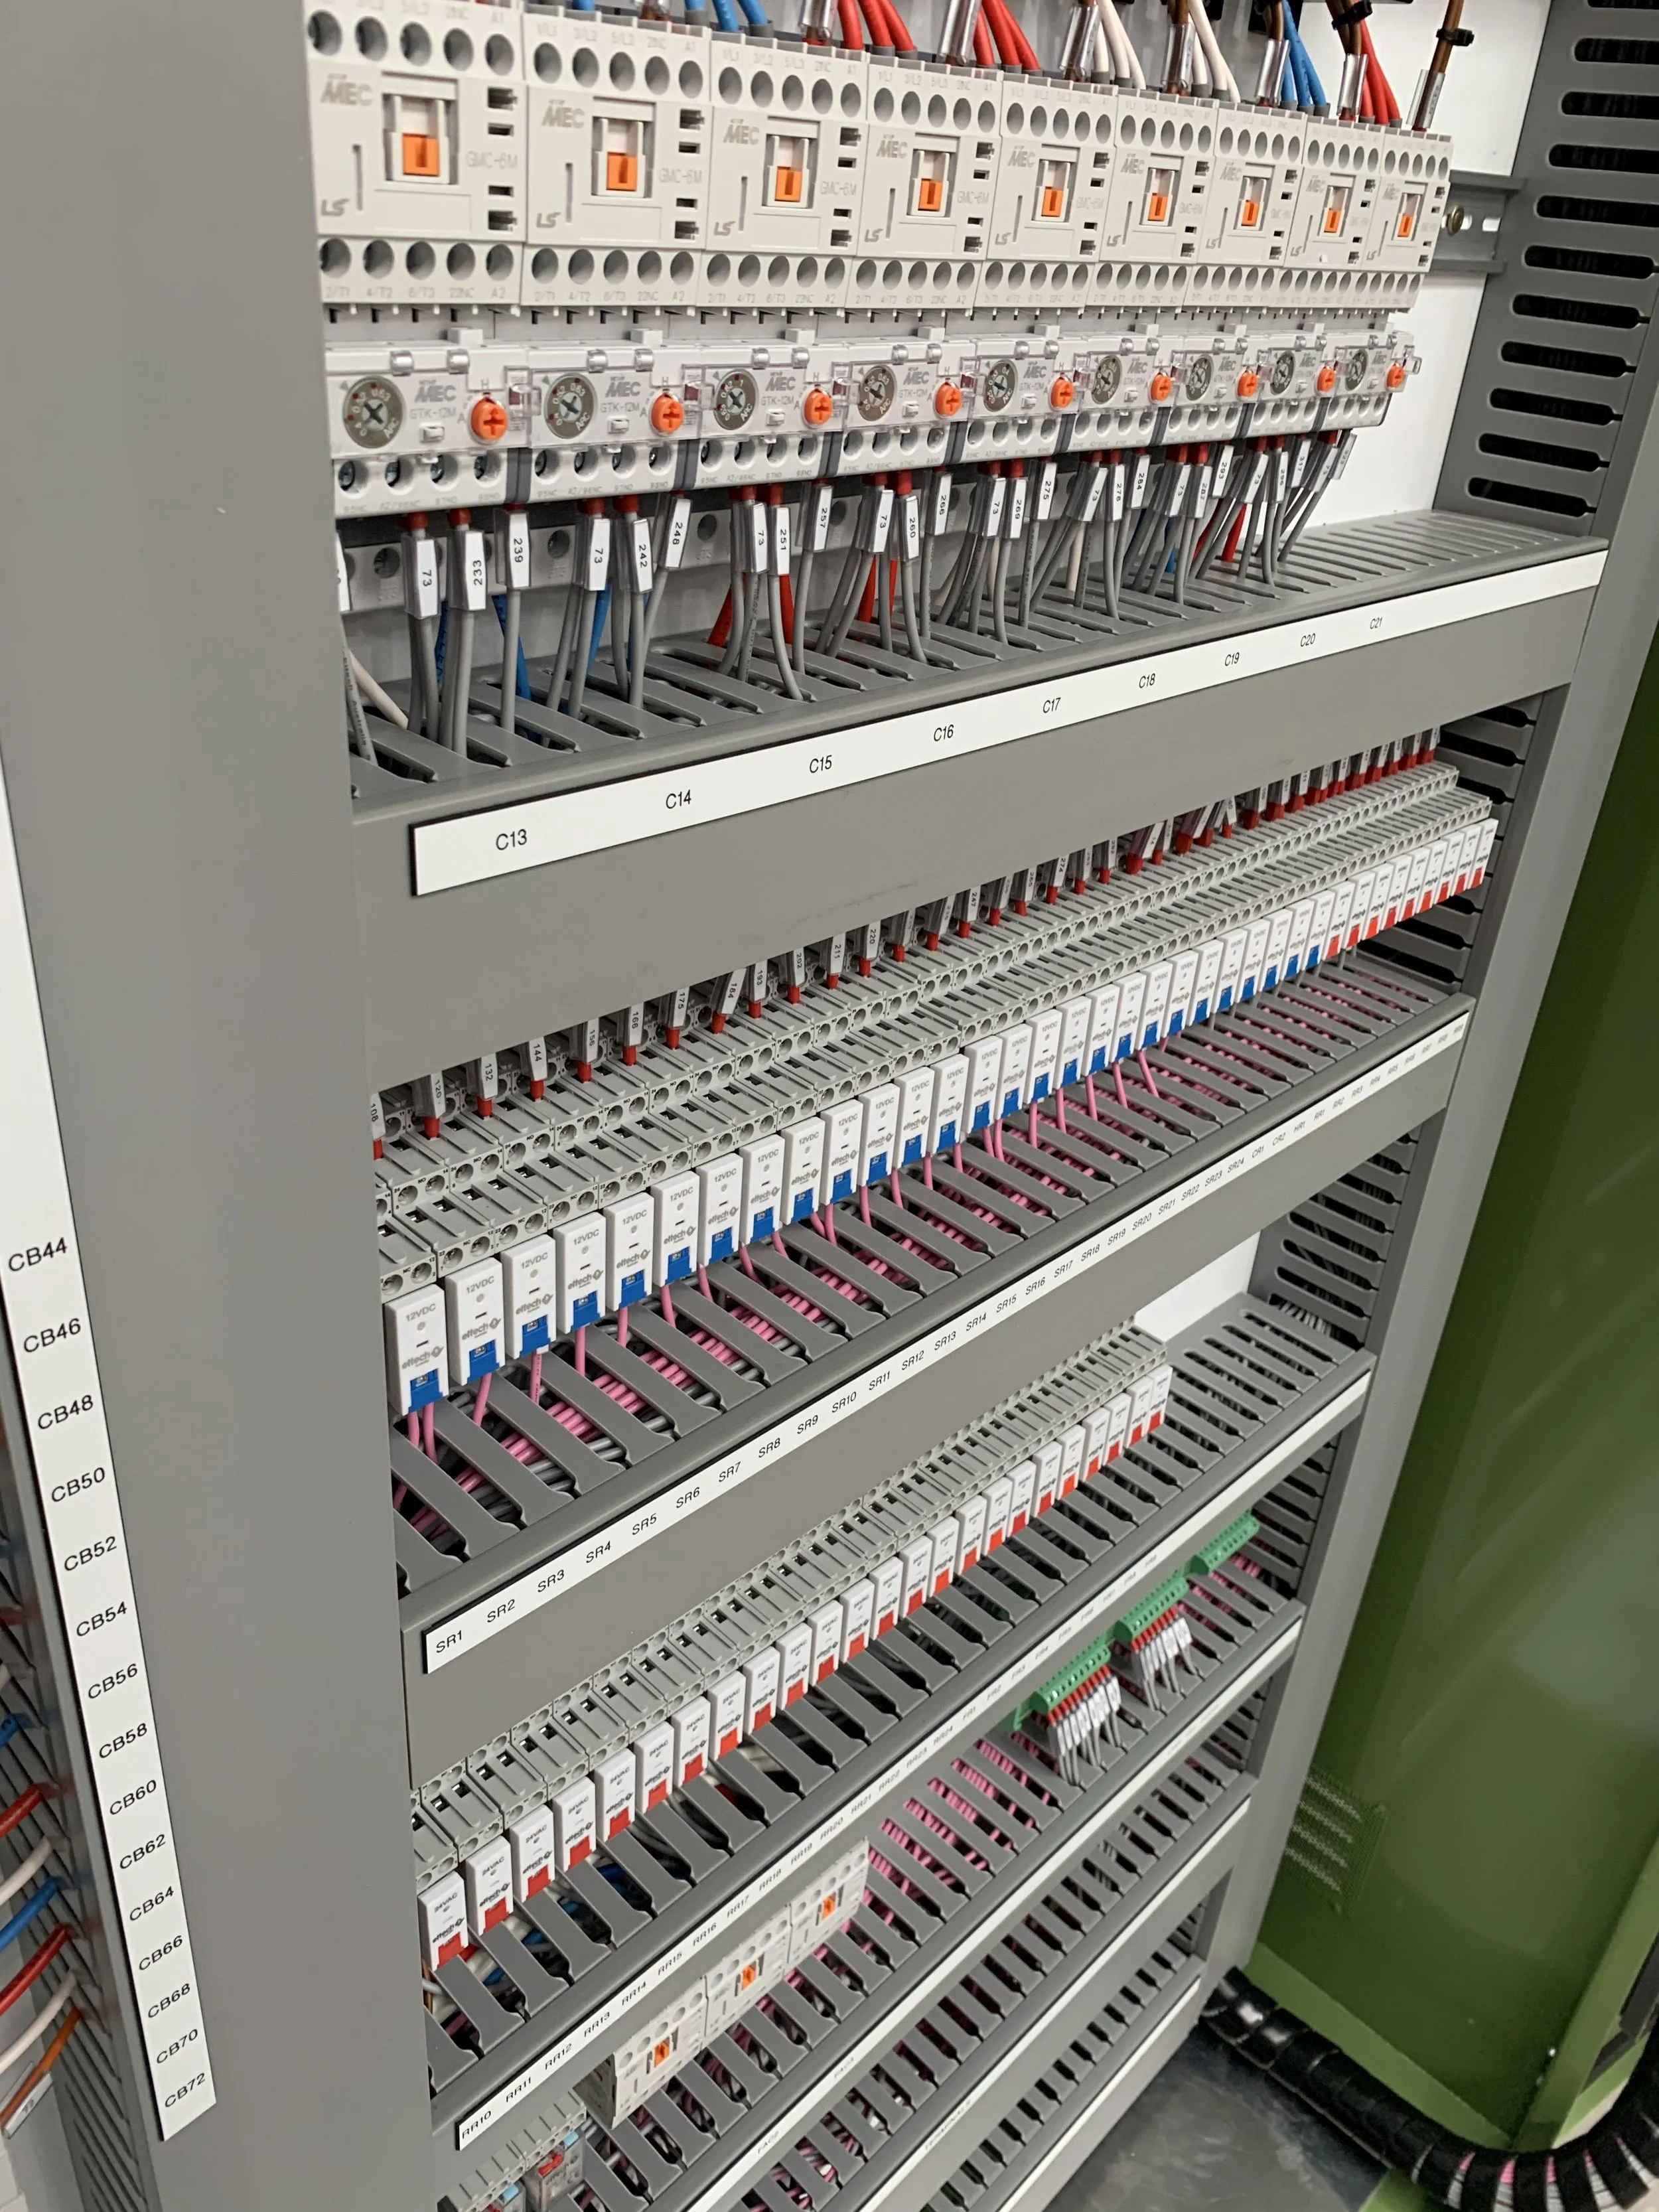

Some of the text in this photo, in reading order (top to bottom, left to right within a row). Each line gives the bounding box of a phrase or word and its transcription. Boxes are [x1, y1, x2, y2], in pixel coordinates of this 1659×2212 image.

[466, 151, 518, 169] GMC-6M
[659, 167, 703, 184] GMC-6M
[820, 181, 857, 195] GMC-6M
[321, 198, 350, 217] LS
[537, 212, 561, 228] LS
[713, 221, 735, 236] LS
[865, 228, 883, 242] LS
[409, 408, 457, 420] GTK-12M
[601, 402, 640, 413] GTK-12M
[1256, 474, 1262, 485] 73
[1092, 490, 1100, 502] 73
[993, 502, 999, 514] 73
[880, 515, 887, 528] 73
[673, 522, 683, 544] 248
[757, 532, 764, 546] 73
[514, 538, 523, 562] 239
[595, 549, 603, 563] 73
[423, 570, 432, 586] 73
[473, 560, 482, 585] 233
[496, 617, 1382, 850] C13 C14 C15 C16 C17 C18 C19 C20 C21
[728, 984, 737, 997] 184
[714, 1168, 737, 1183] 12VDC
[670, 1187, 693, 1202] 12VDC
[622, 1209, 647, 1225] 12VDC
[573, 1228, 599, 1245] 12VDC
[9, 1238, 66, 1271] CB44
[521, 1252, 548, 1270] 12VDC
[467, 1276, 495, 1294] 12VDC
[405, 1303, 436, 1322] 12VDC
[24, 1318, 80, 1353] CB46
[437, 1631, 461, 1653] SR1
[488, 1599, 514, 1623] SR2
[538, 1570, 564, 1592] SR3
[587, 1541, 611, 1563] SR4
[632, 1513, 656, 1535] SR5
[676, 1487, 699, 1508] SR6
[719, 1461, 741, 1482] SR7
[758, 1438, 780, 1457] SR8
[798, 1415, 818, 1434] SR9
[832, 1392, 856, 1412] SR10
[869, 1371, 889, 1390] SR11
[902, 1351, 924, 1370] SR12
[935, 1331, 956, 1350] SR13
[966, 1313, 985, 1331] SR14
[997, 1295, 1016, 1312] SR15
[1026, 1277, 1045, 1295] SR16
[1054, 1260, 1072, 1278] SR17
[1082, 1244, 1100, 1261] SR18
[1108, 1228, 1125, 1245] SR19
[1133, 1213, 1151, 1230] SR20
[1159, 1199, 1176, 1215] SR21
[1182, 1185, 1199, 1201] SR22
[1206, 1171, 1222, 1186] SR23
[1228, 1157, 1244, 1173] SR24
[1252, 1145, 1263, 1158] CR1
[1273, 1133, 1285, 1145] CR2
[1294, 1121, 1305, 1133] HR1
[1314, 1108, 1325, 1120] RR1
[38, 1395, 93, 1429] CB48
[52, 1467, 105, 1502] CB50
[64, 1536, 117, 1571] CB52
[77, 1601, 127, 1636] CB54
[88, 1664, 137, 1698] CB56
[100, 1723, 147, 1758] CB58
[110, 1780, 156, 1814] CB60
[568, 1797, 589, 1814] 24VAC
[526, 1824, 547, 1843] 24VAC
[120, 1834, 165, 1869] CB62
[482, 1856, 504, 1876] 24VAC
[130, 1886, 173, 1921] CB64
[434, 1892, 458, 1913] 24VAC
[463, 2111, 490, 2138] RR10
[506, 2077, 530, 2102] RR11
[545, 2043, 571, 2069] RR12
[585, 2012, 609, 2037] RR13
[622, 1982, 646, 2005] RR14
[658, 1954, 682, 1974] RR15
[693, 1925, 716, 1945] RR16
[727, 1897, 749, 1918] RR17
[760, 1870, 780, 1889] RR18
[792, 1844, 812, 1863] RR19
[820, 1818, 843, 1838] RR20
[851, 1794, 872, 1813] RR21
[879, 1771, 900, 1791] RR22
[906, 1748, 927, 1767] RR23
[934, 1726, 953, 1745] RR24
[139, 1935, 182, 1970] CB66
[148, 1984, 190, 2018] CB68
[157, 2029, 198, 2063] CB70
[165, 2073, 205, 2107] CB72
